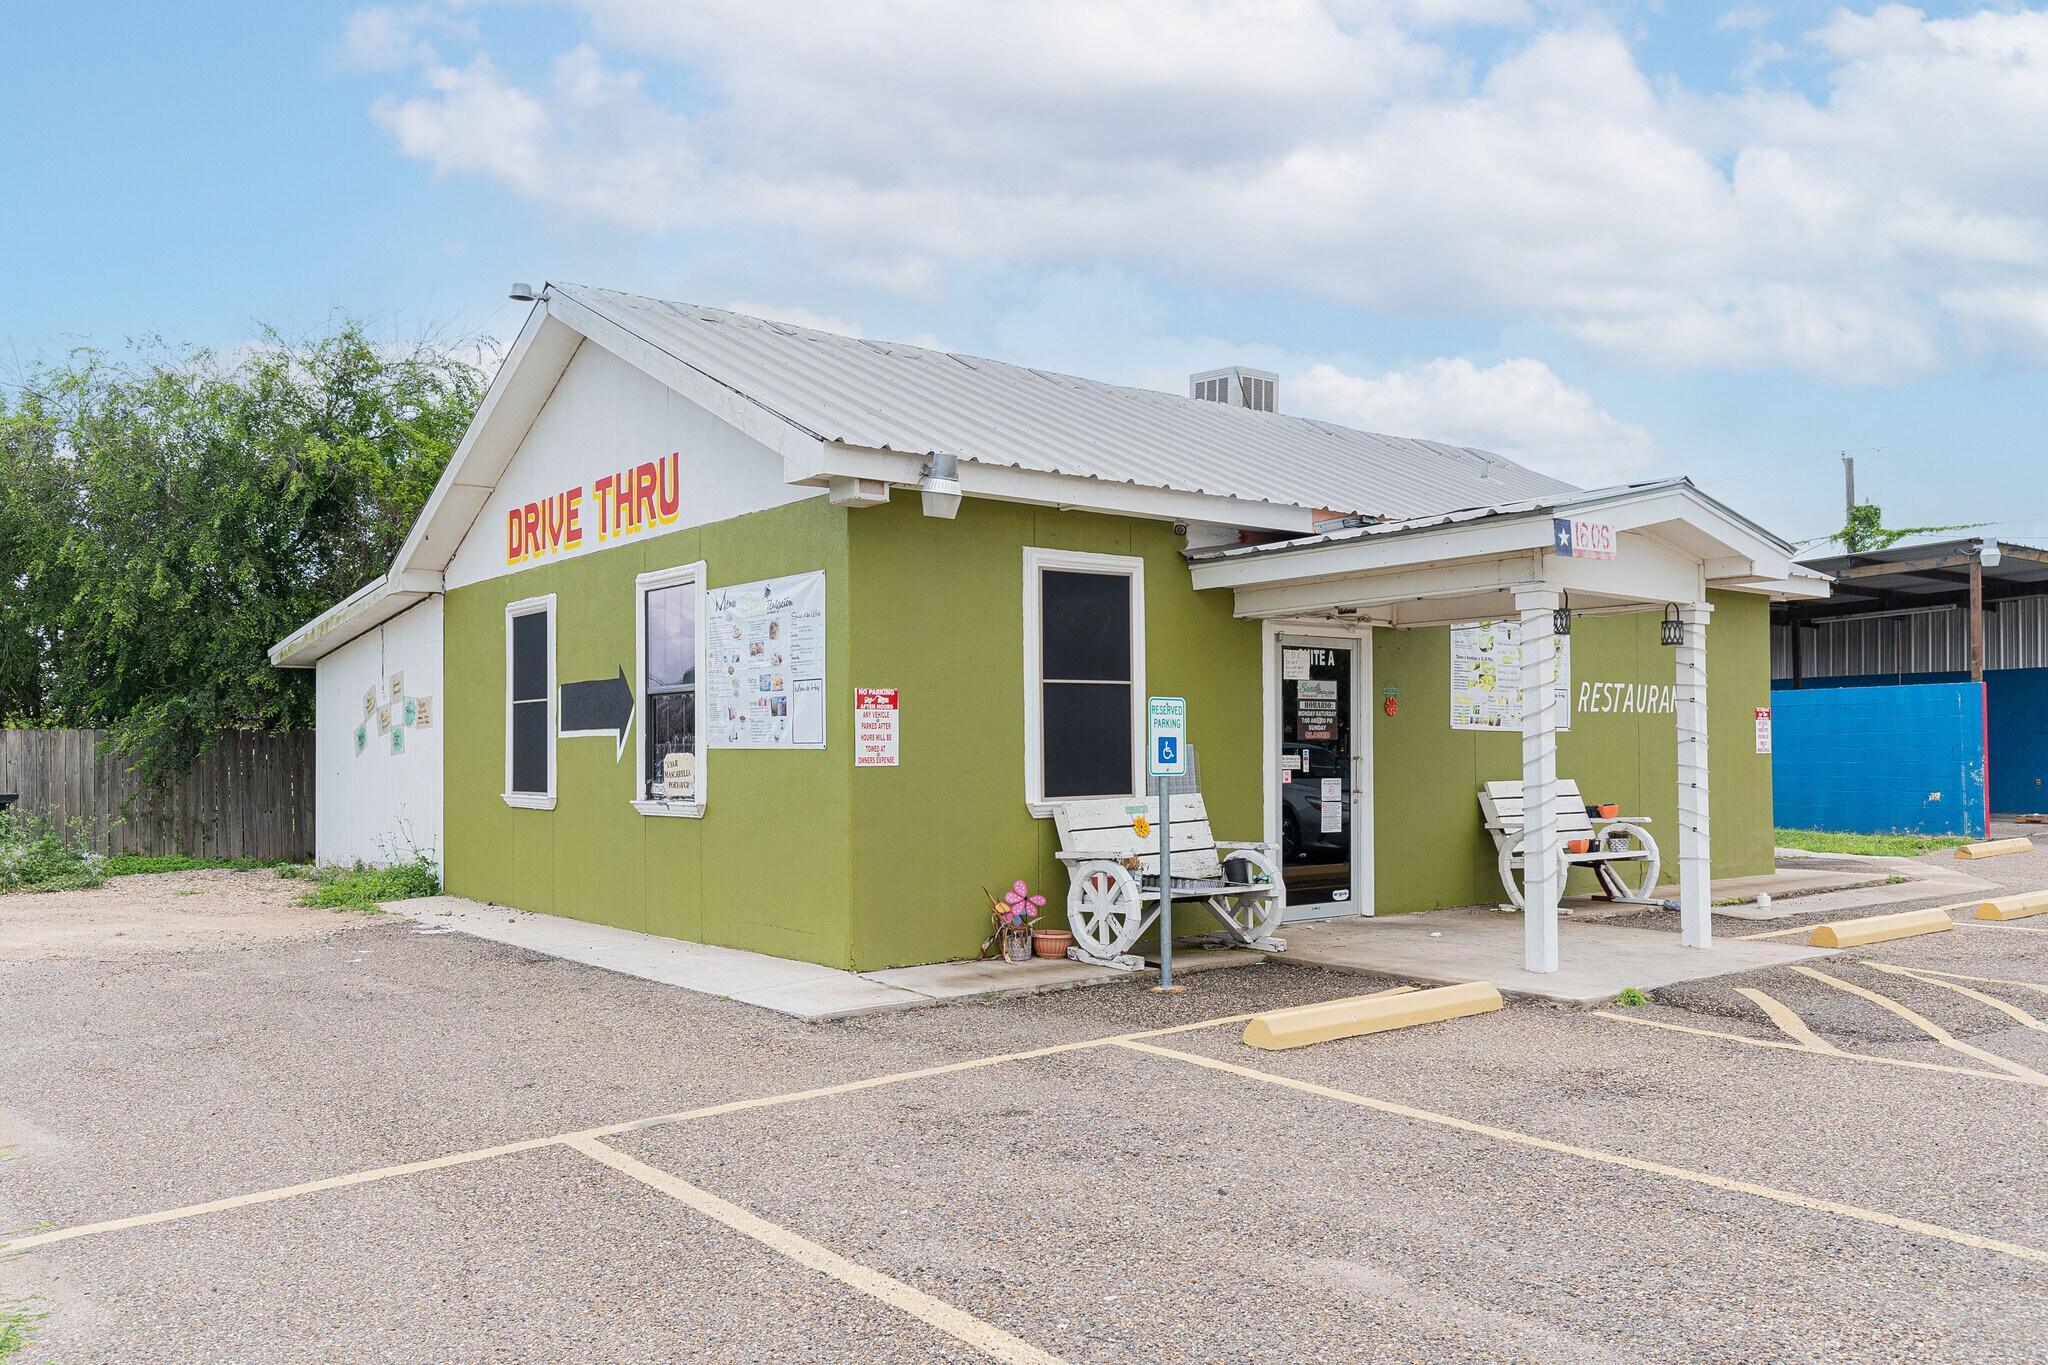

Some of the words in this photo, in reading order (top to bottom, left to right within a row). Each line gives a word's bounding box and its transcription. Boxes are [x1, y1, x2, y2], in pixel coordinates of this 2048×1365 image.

[507, 486, 583, 565] DRIVE
[592, 452, 679, 542] THRU
[1328, 650, 1335, 666] A
[1578, 681, 1677, 713] RESTAURAN
[1152, 704, 1182, 716] RESERVED
[1154, 718, 1181, 728] PARKING
